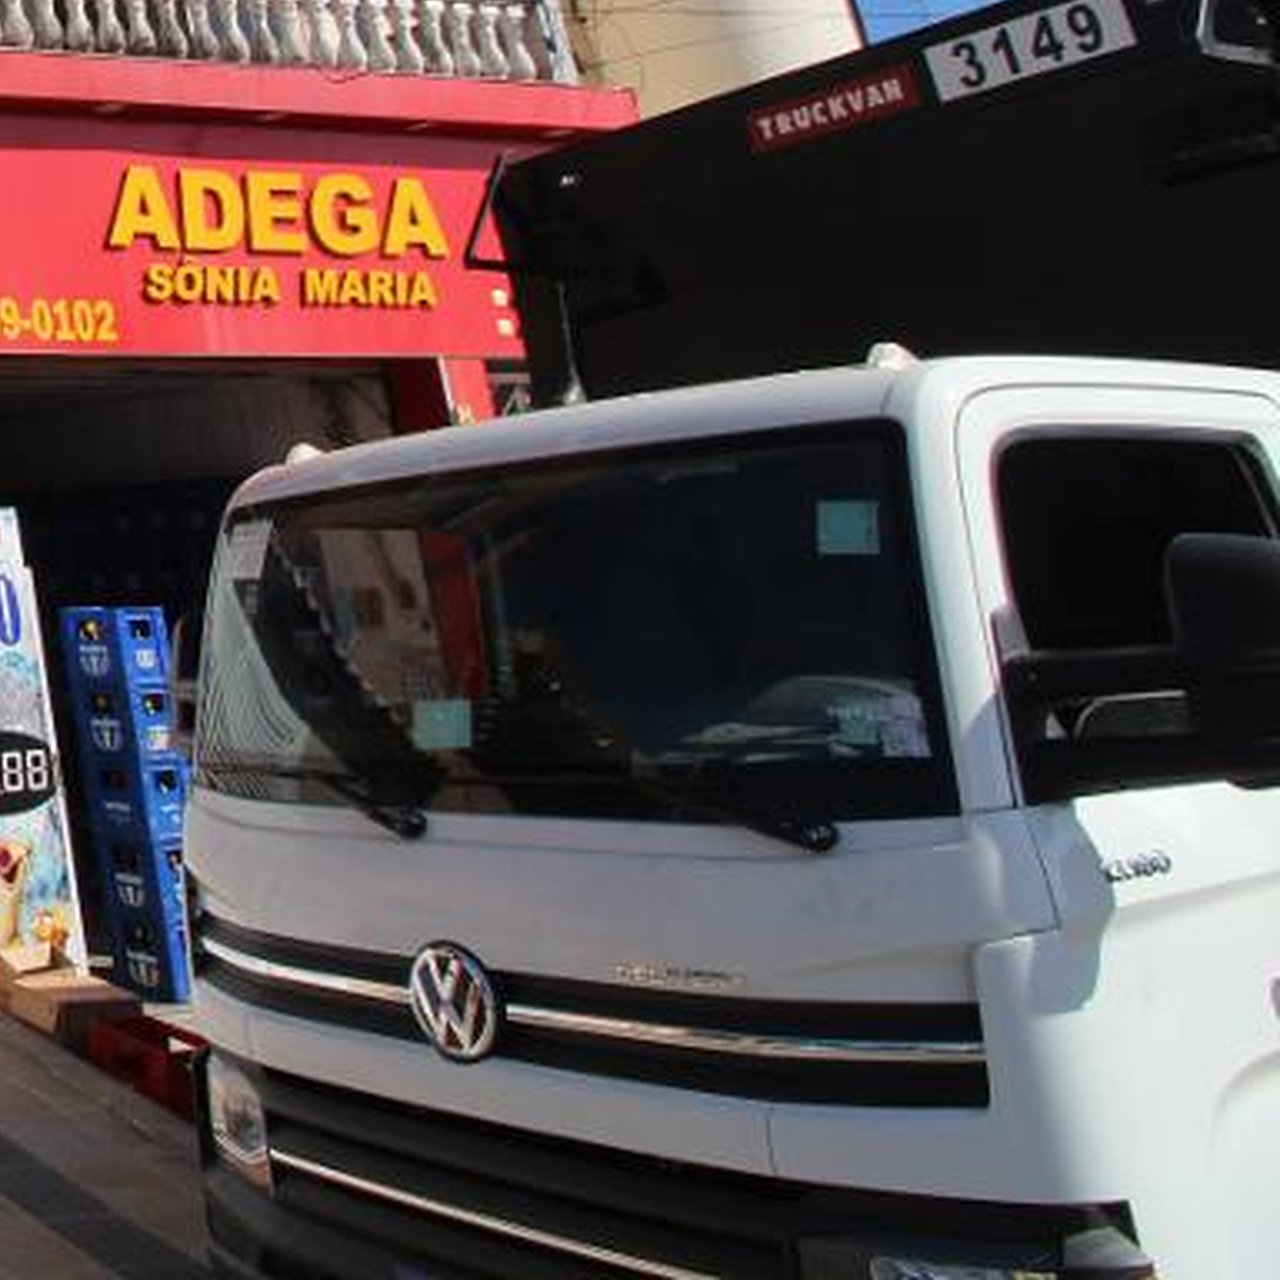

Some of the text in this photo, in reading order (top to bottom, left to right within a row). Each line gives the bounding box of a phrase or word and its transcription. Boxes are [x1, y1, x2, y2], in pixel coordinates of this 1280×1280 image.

[951, 4, 1103, 87] 3149
[756, 77, 905, 141] TRUCKVAN
[106, 164, 450, 260] ADEGA
[302, 269, 437, 308] MARIA
